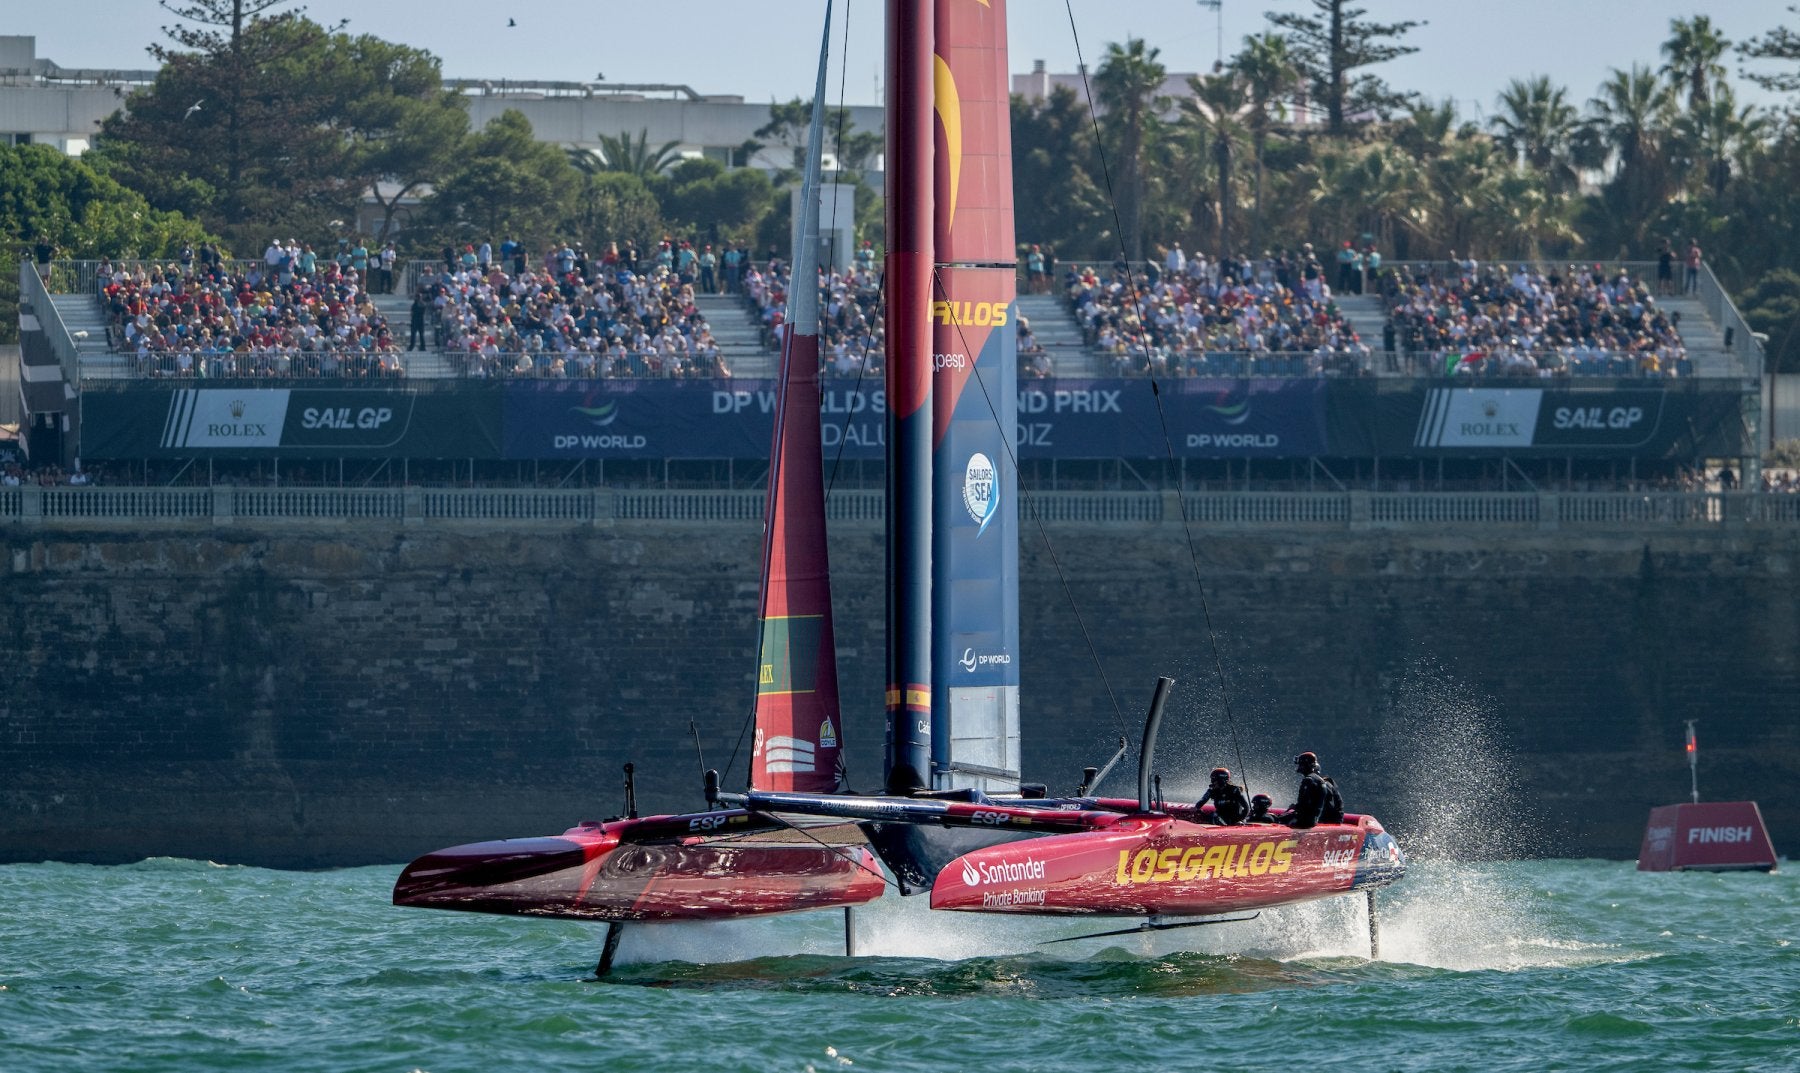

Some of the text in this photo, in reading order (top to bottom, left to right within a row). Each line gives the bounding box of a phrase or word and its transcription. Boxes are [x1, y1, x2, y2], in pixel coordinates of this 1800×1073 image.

[712, 390, 753, 414] DP
[1054, 390, 1122, 413] PRIX
[208, 423, 267, 437] ROLEX
[1460, 422, 1520, 436] ROLEX
[554, 435, 647, 448] DP WORLD
[1187, 434, 1279, 447] DP WORLD
[969, 468, 992, 480] SAILORS
[975, 482, 992, 501] SEA
[979, 654, 1010, 664] DP WORLD
[689, 815, 726, 832] ESP
[971, 811, 1010, 825] ESP
[1688, 826, 1752, 844] FINISH
[979, 857, 1046, 884] Santander
[983, 888, 1046, 908] Private Banking
